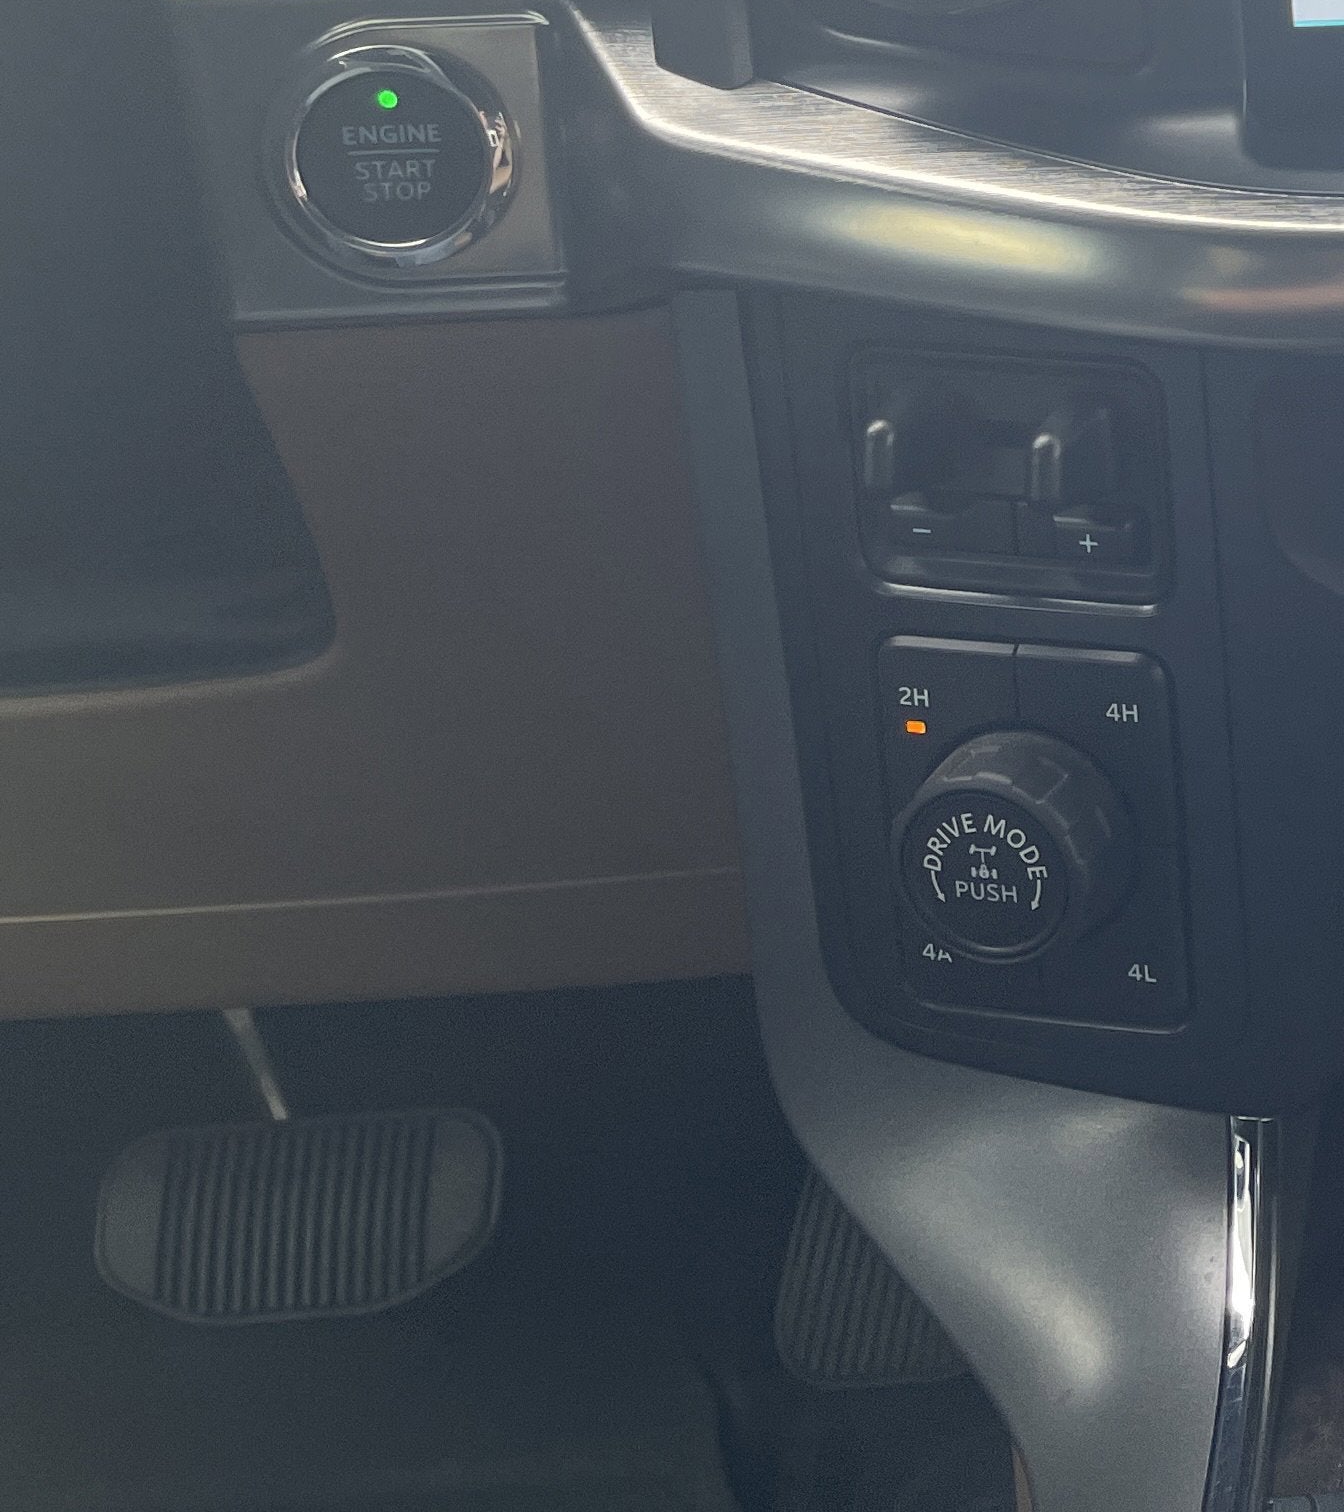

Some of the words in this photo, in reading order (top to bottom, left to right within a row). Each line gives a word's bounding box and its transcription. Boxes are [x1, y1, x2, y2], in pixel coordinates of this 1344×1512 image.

[341, 123, 443, 146] ENGINE
[355, 159, 436, 180] START
[362, 181, 432, 203] STOP
[898, 686, 930, 709] 2H
[1105, 702, 1139, 724] 4H
[923, 812, 977, 872] DRIVE
[983, 814, 1049, 880] MODE
[955, 880, 1019, 904] PUSH
[1127, 963, 1157, 984] 4L
